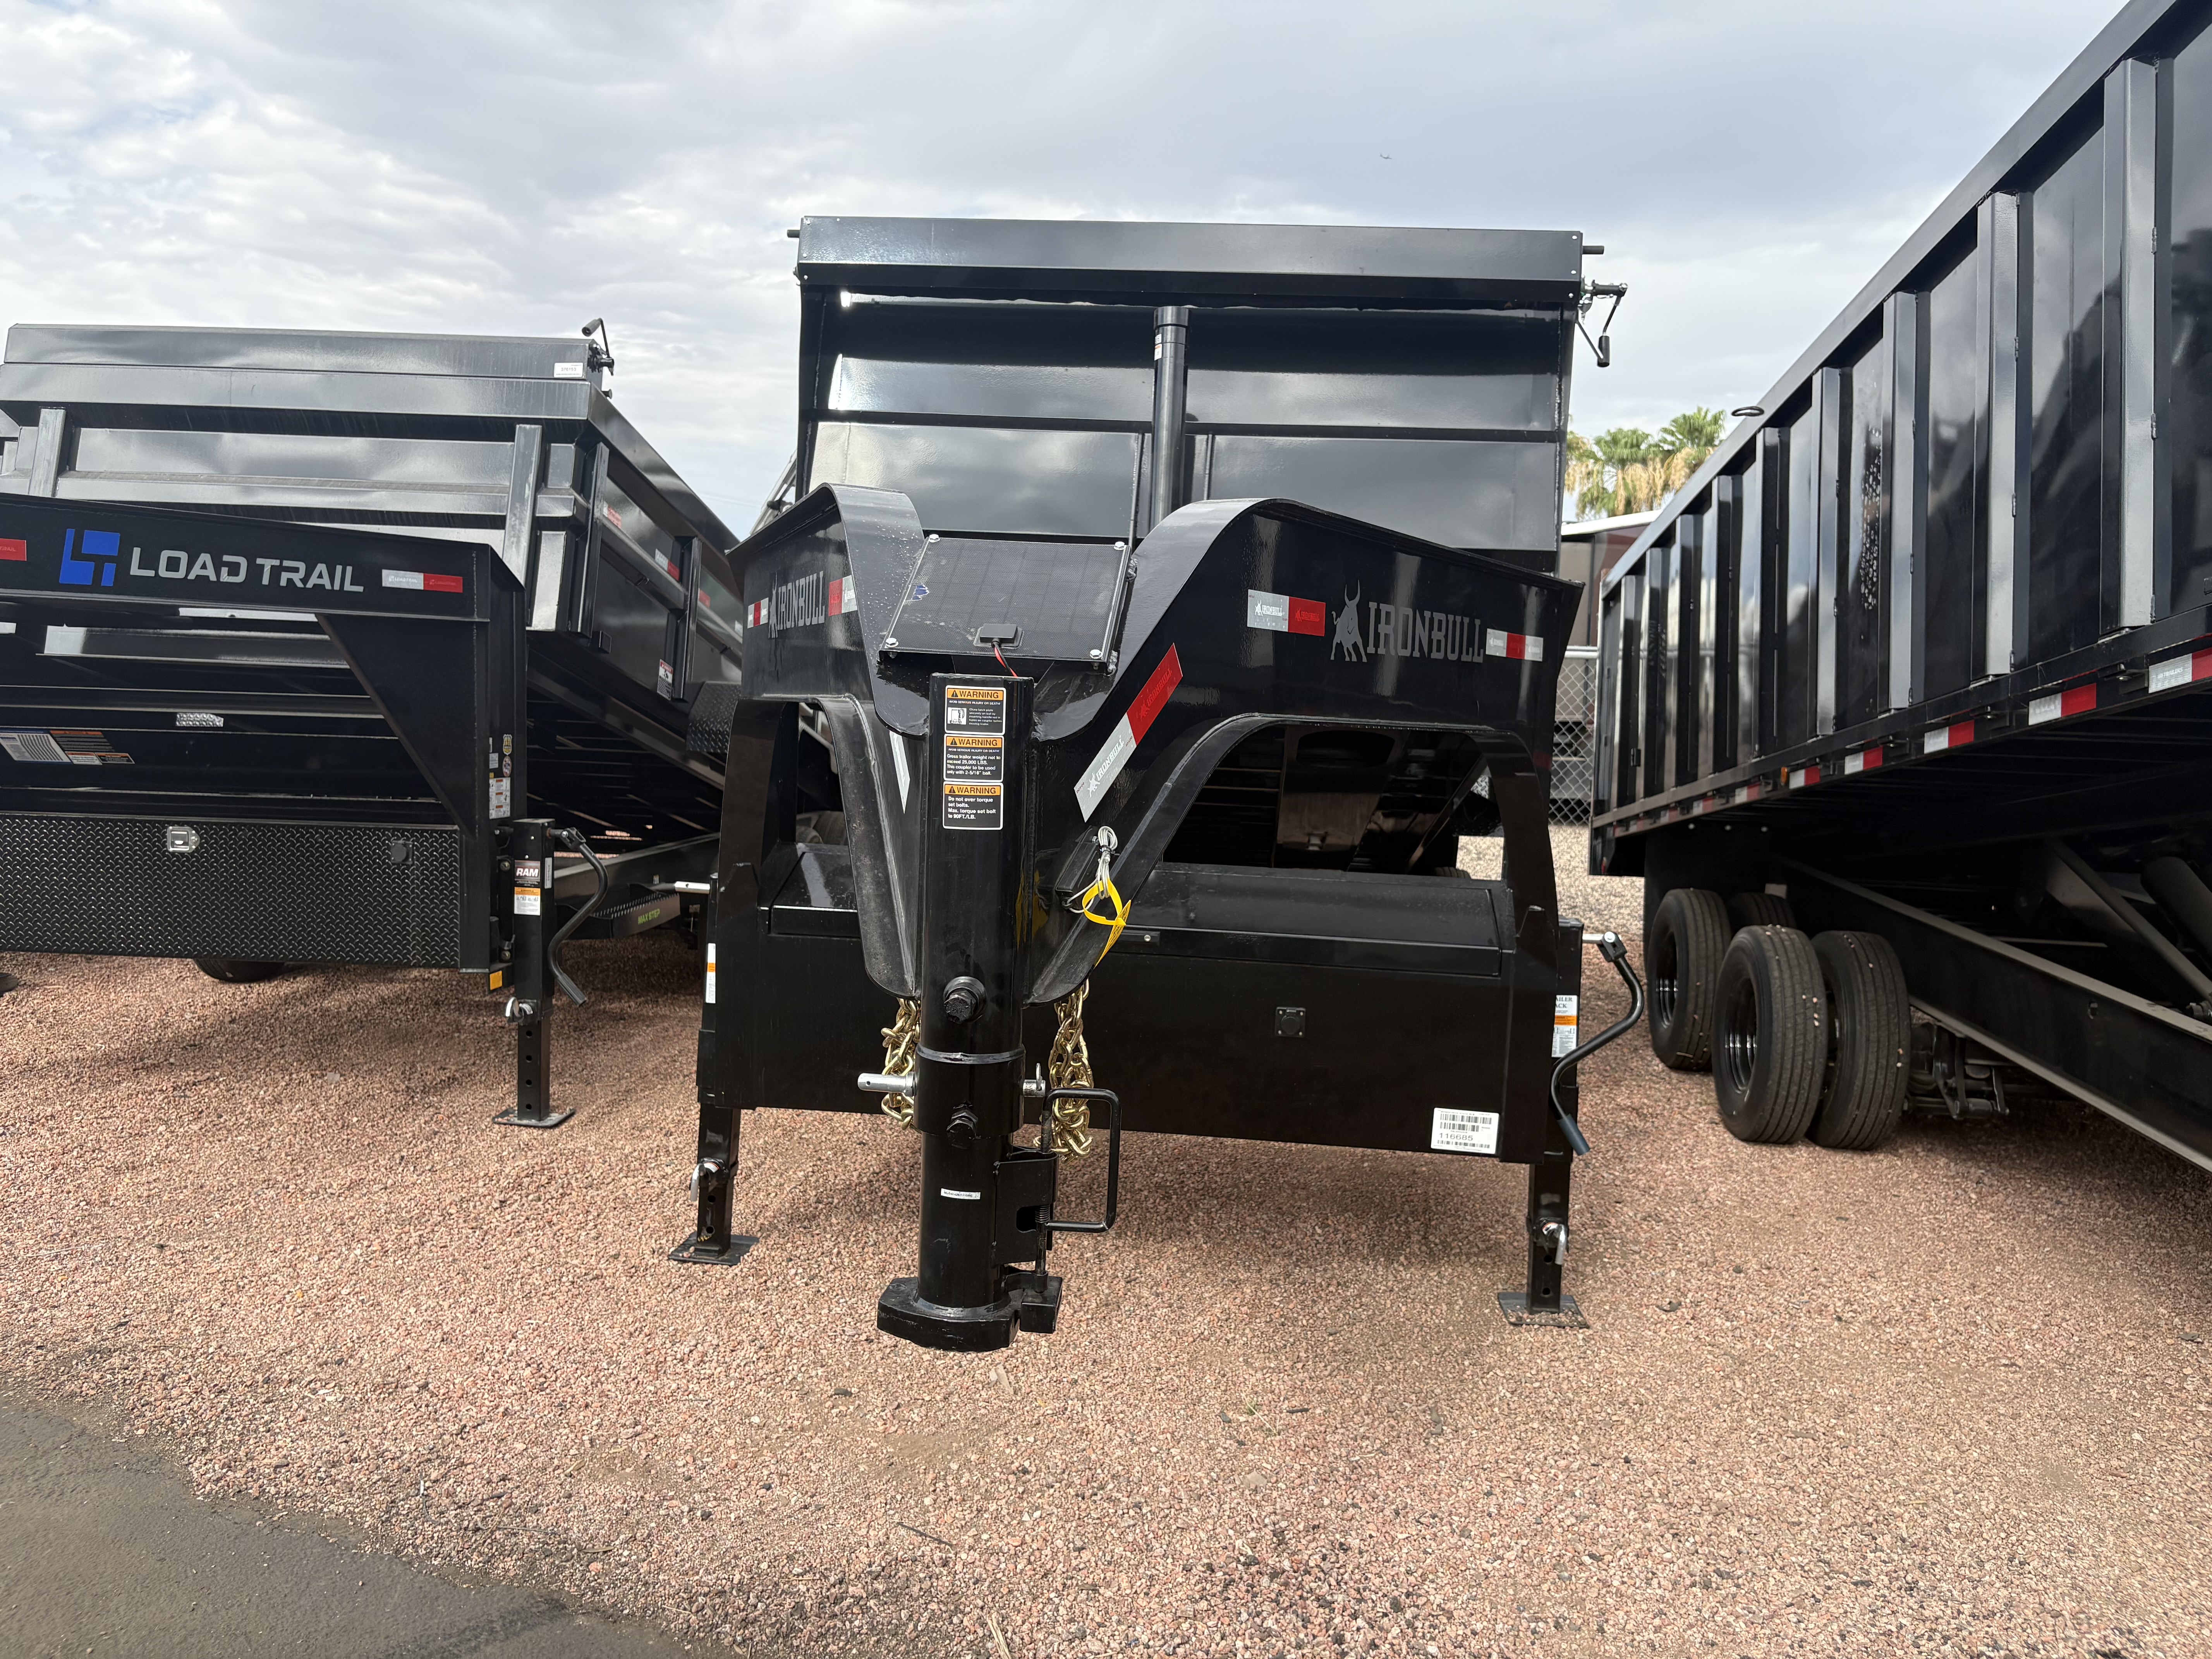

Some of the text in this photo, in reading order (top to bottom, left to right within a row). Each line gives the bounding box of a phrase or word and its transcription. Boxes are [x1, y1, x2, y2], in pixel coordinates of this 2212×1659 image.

[130, 547, 364, 592] LOAD TRAIL
[777, 571, 825, 630] IRONBULL
[1262, 605, 1283, 615] IRONBULL
[1367, 601, 1484, 663] IRONBULL
[960, 690, 999, 699] WARNING
[1096, 738, 1124, 781] IRONBULL
[516, 868, 539, 877] RAM
[638, 908, 660, 925] MAX STEP
[1439, 1133, 1473, 1141] 116685
